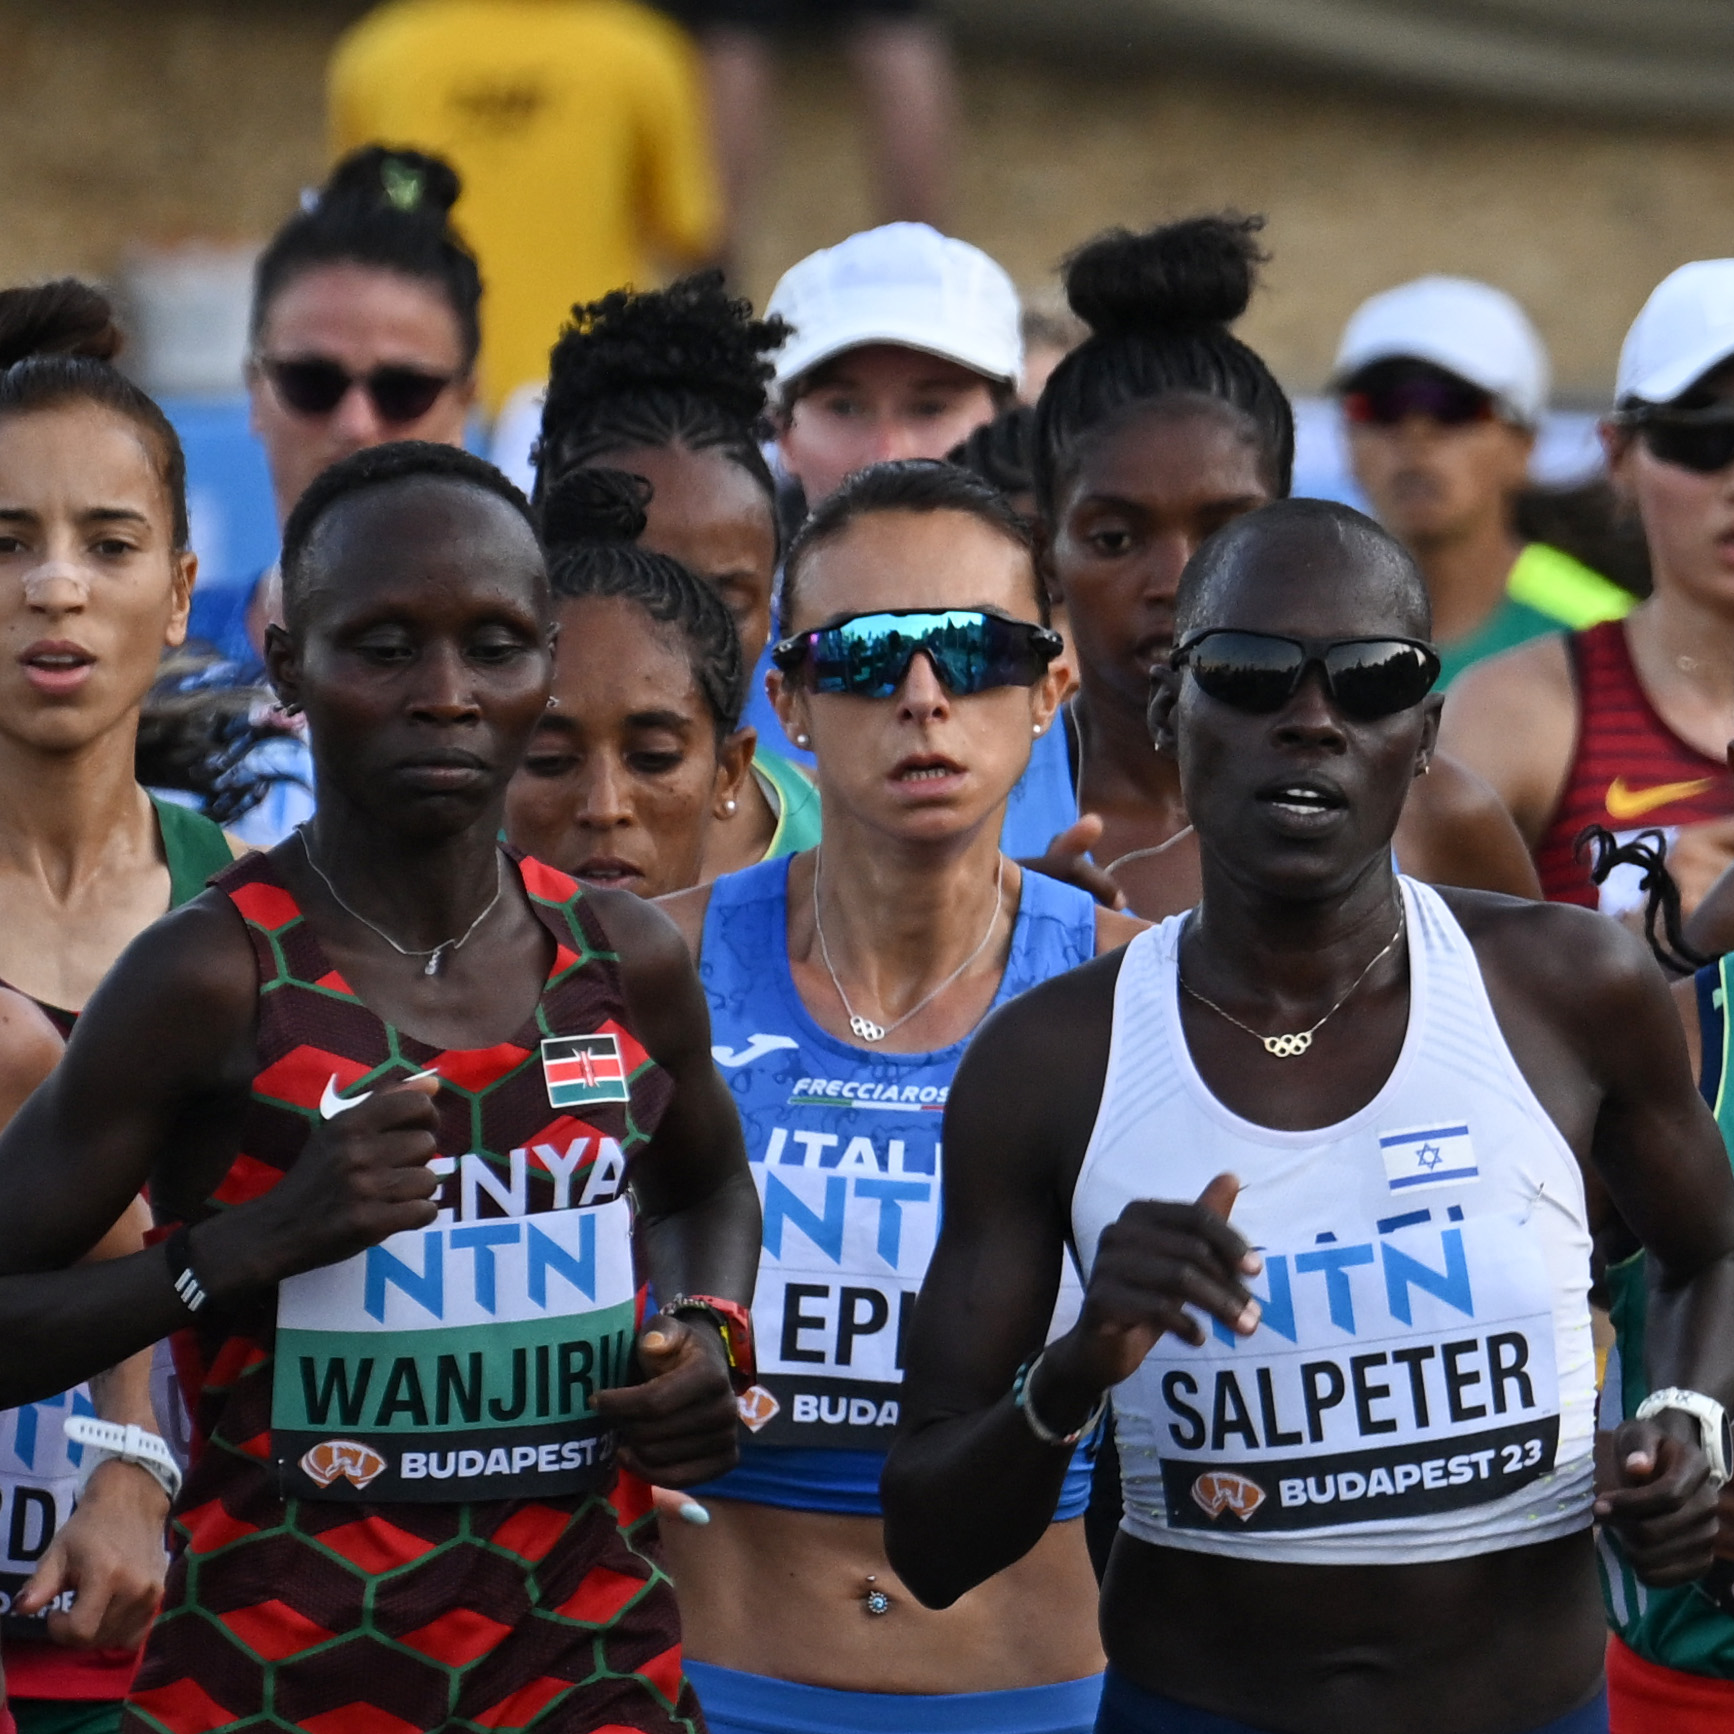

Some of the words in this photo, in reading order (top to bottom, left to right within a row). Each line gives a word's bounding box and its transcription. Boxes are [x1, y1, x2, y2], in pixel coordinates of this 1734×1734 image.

[793, 1077, 949, 1103] FRECCIAROS
[764, 1127, 941, 1176] ITAL
[762, 1170, 931, 1271] NT
[364, 1213, 596, 1324] NTN
[793, 1394, 898, 1427] BUDA
[1161, 1331, 1537, 1452] SALPETER
[401, 1437, 599, 1480] BUDAPEST
[1278, 1447, 1496, 1508] BUDAPEST
[1500, 1438, 1543, 1474] 23
